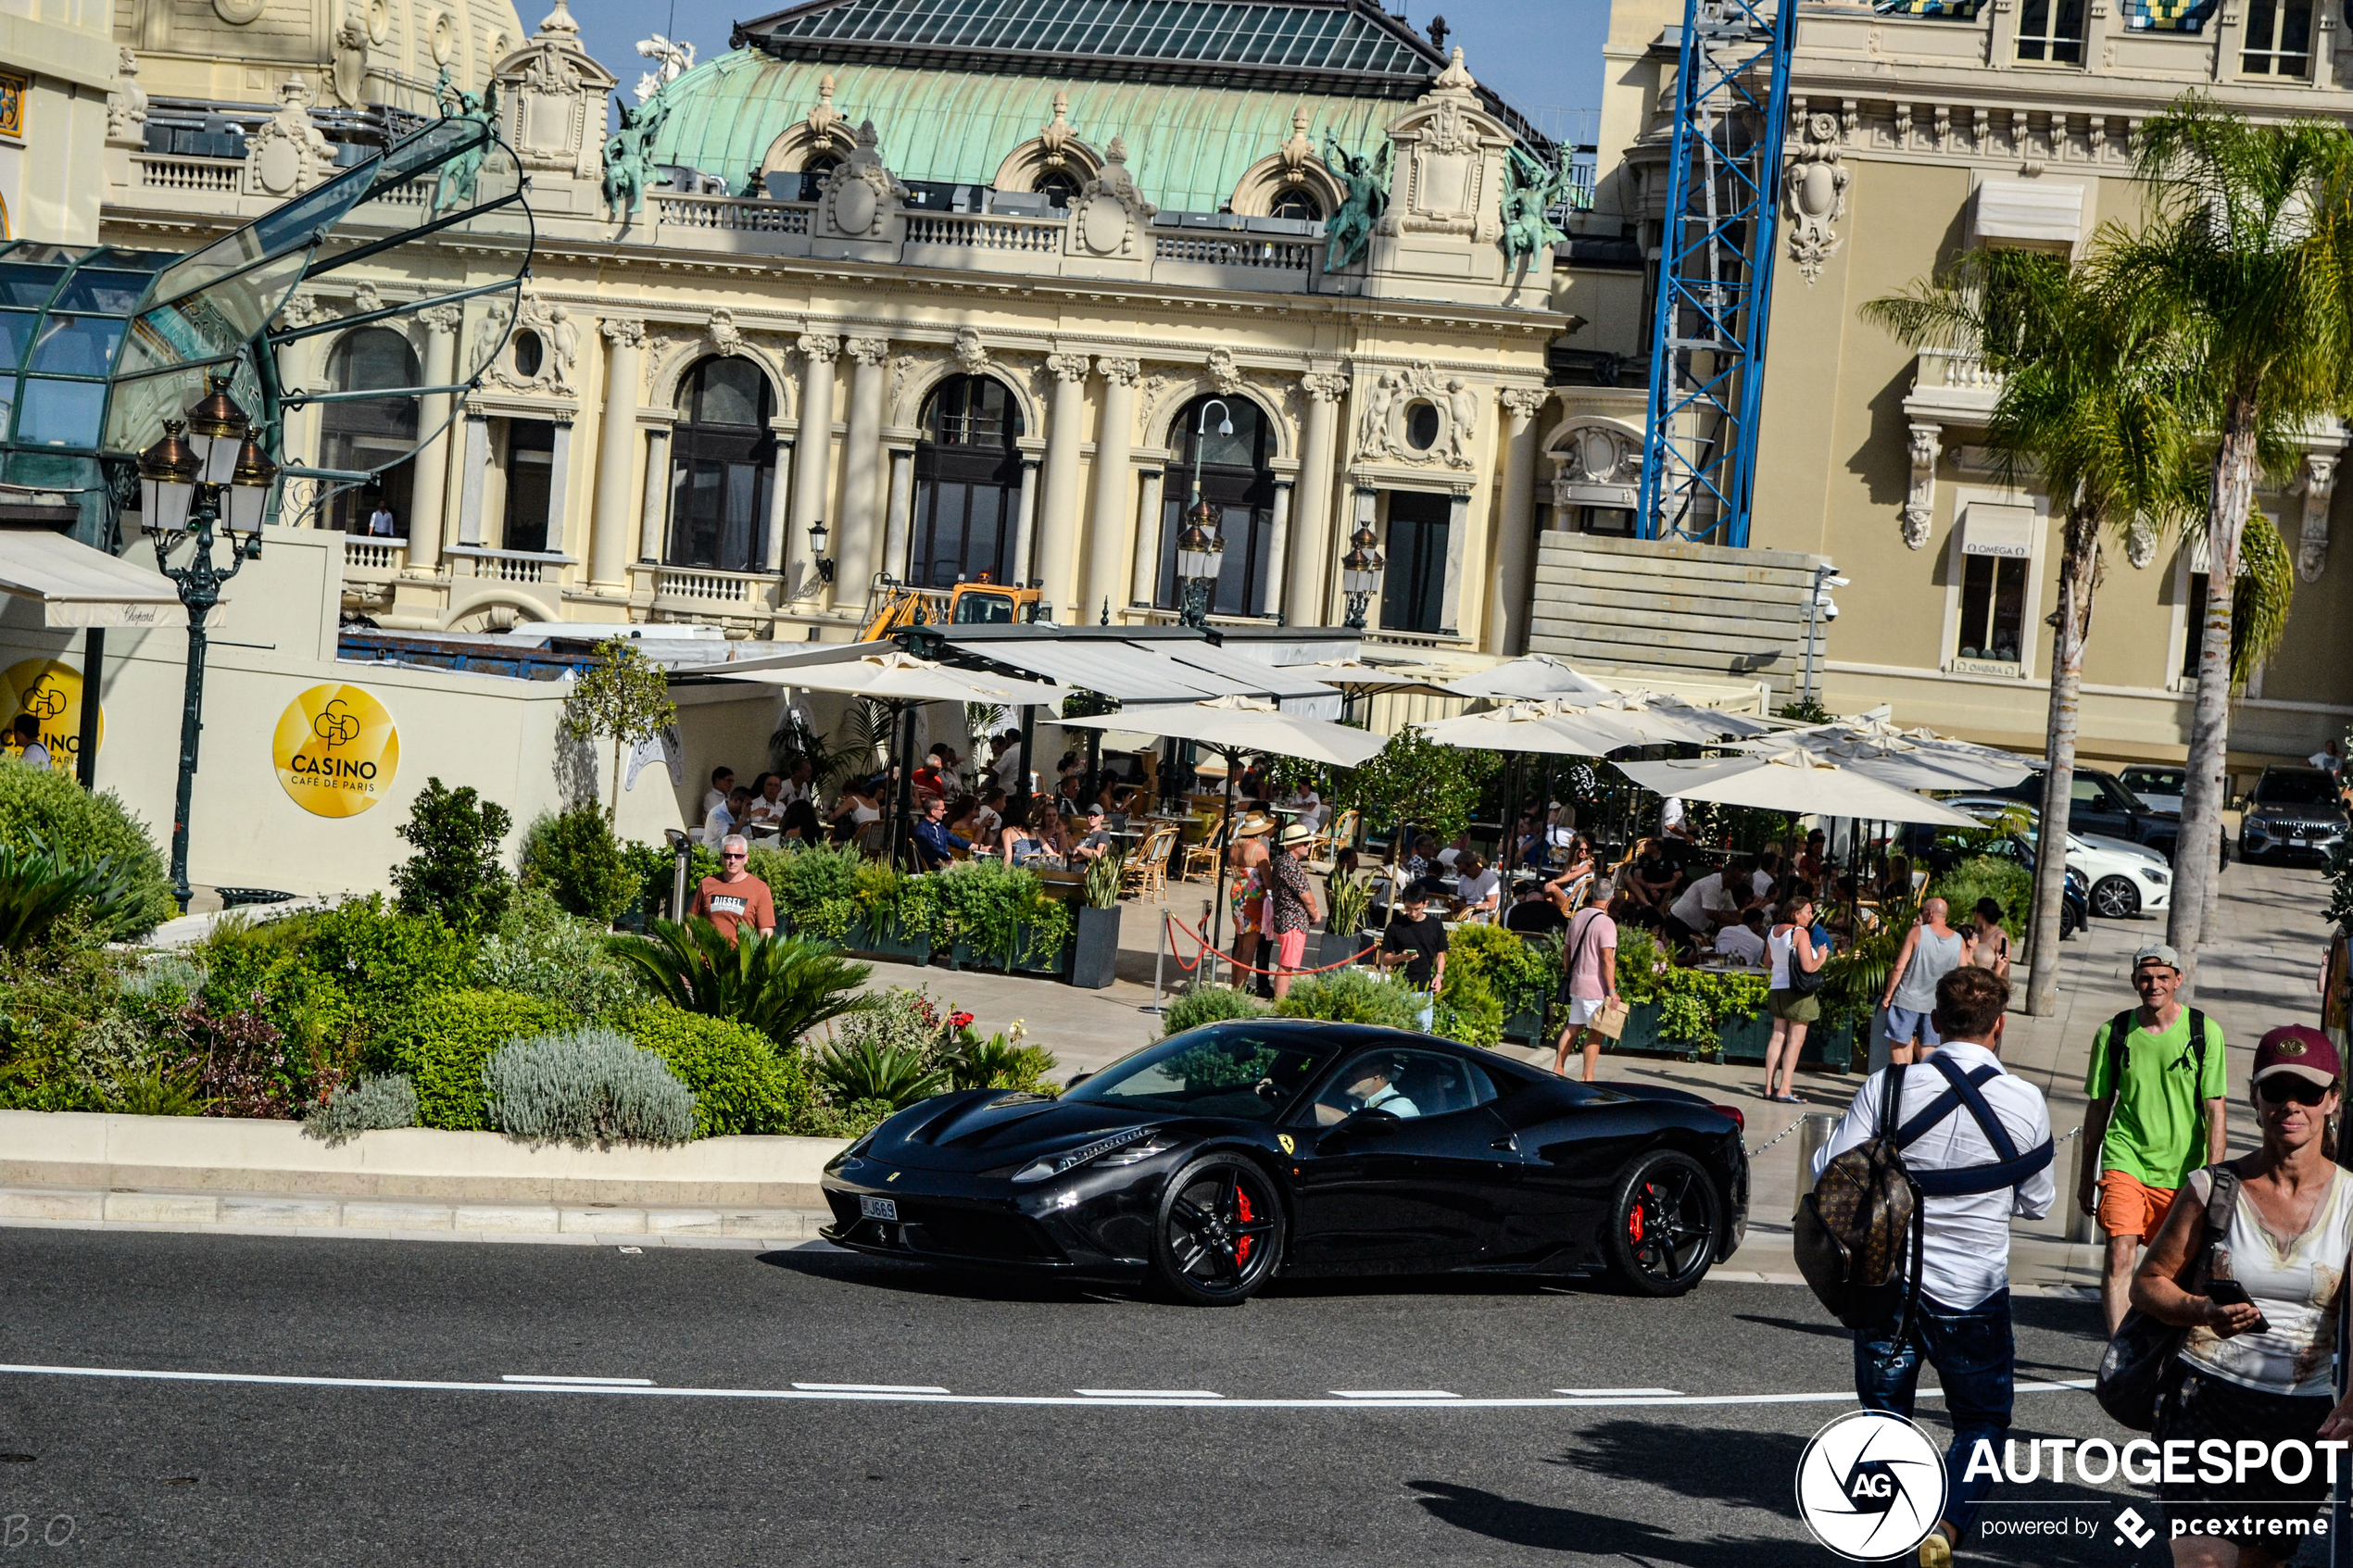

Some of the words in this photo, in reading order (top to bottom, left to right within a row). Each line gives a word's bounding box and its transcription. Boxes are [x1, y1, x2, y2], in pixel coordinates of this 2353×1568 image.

[1979, 545, 2013, 555] OMEGA
[122, 603, 157, 626] Chopard
[1969, 664, 2003, 674] OMEGA
[0, 729, 81, 753] CINO
[292, 755, 377, 780] CASINO
[291, 775, 319, 786] CAFÉ
[323, 779, 337, 788] DE
[343, 781, 374, 792] PARIS
[713, 896, 741, 908] DIESEL
